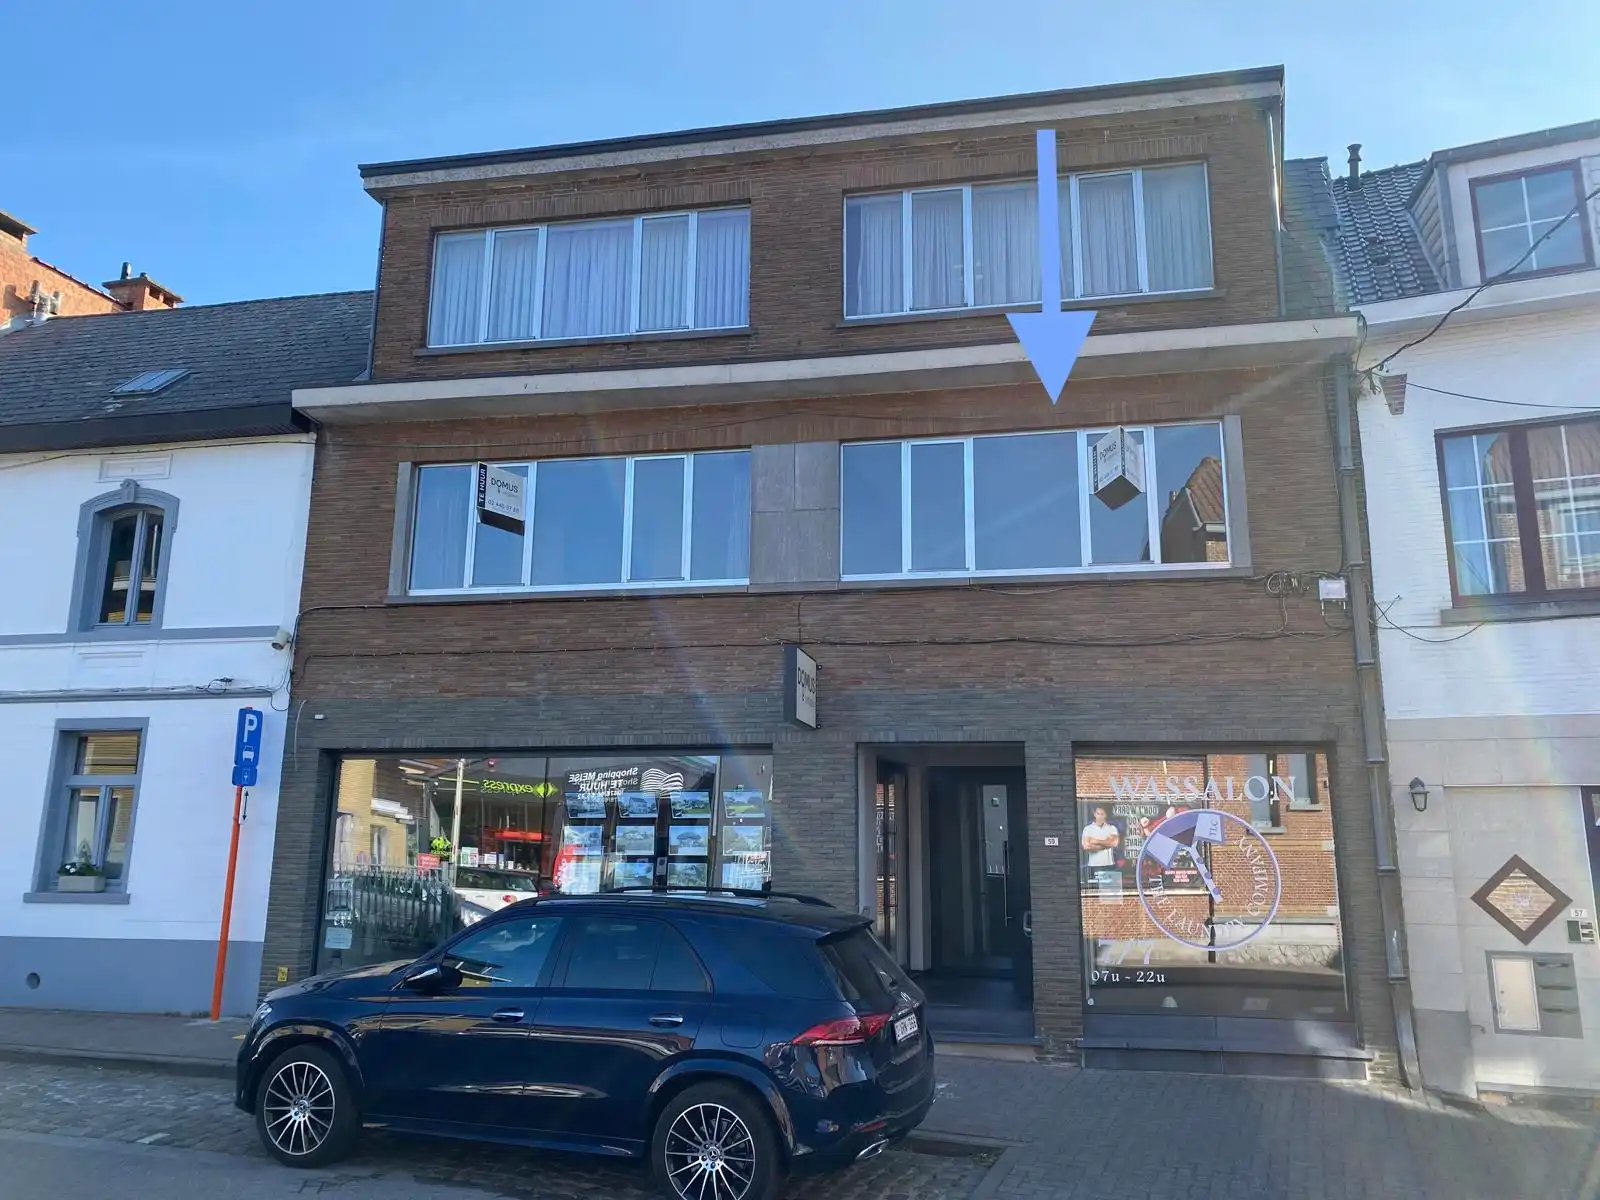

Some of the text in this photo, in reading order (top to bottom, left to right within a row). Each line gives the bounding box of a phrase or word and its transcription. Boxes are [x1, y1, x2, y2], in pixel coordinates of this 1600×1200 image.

[491, 477, 519, 493] DOMUS
[798, 667, 816, 694] DOMUS
[243, 714, 257, 742] P
[1109, 775, 1297, 802] WASSALON
[1209, 819, 1218, 837] TLC
[1149, 875, 1171, 906] THE
[1167, 909, 1245, 941] LAUNRY
[1233, 836, 1269, 917] COMPANY
[1575, 909, 1584, 917] 57
[1091, 970, 1121, 983] 07u
[1136, 970, 1167, 983] 22u
